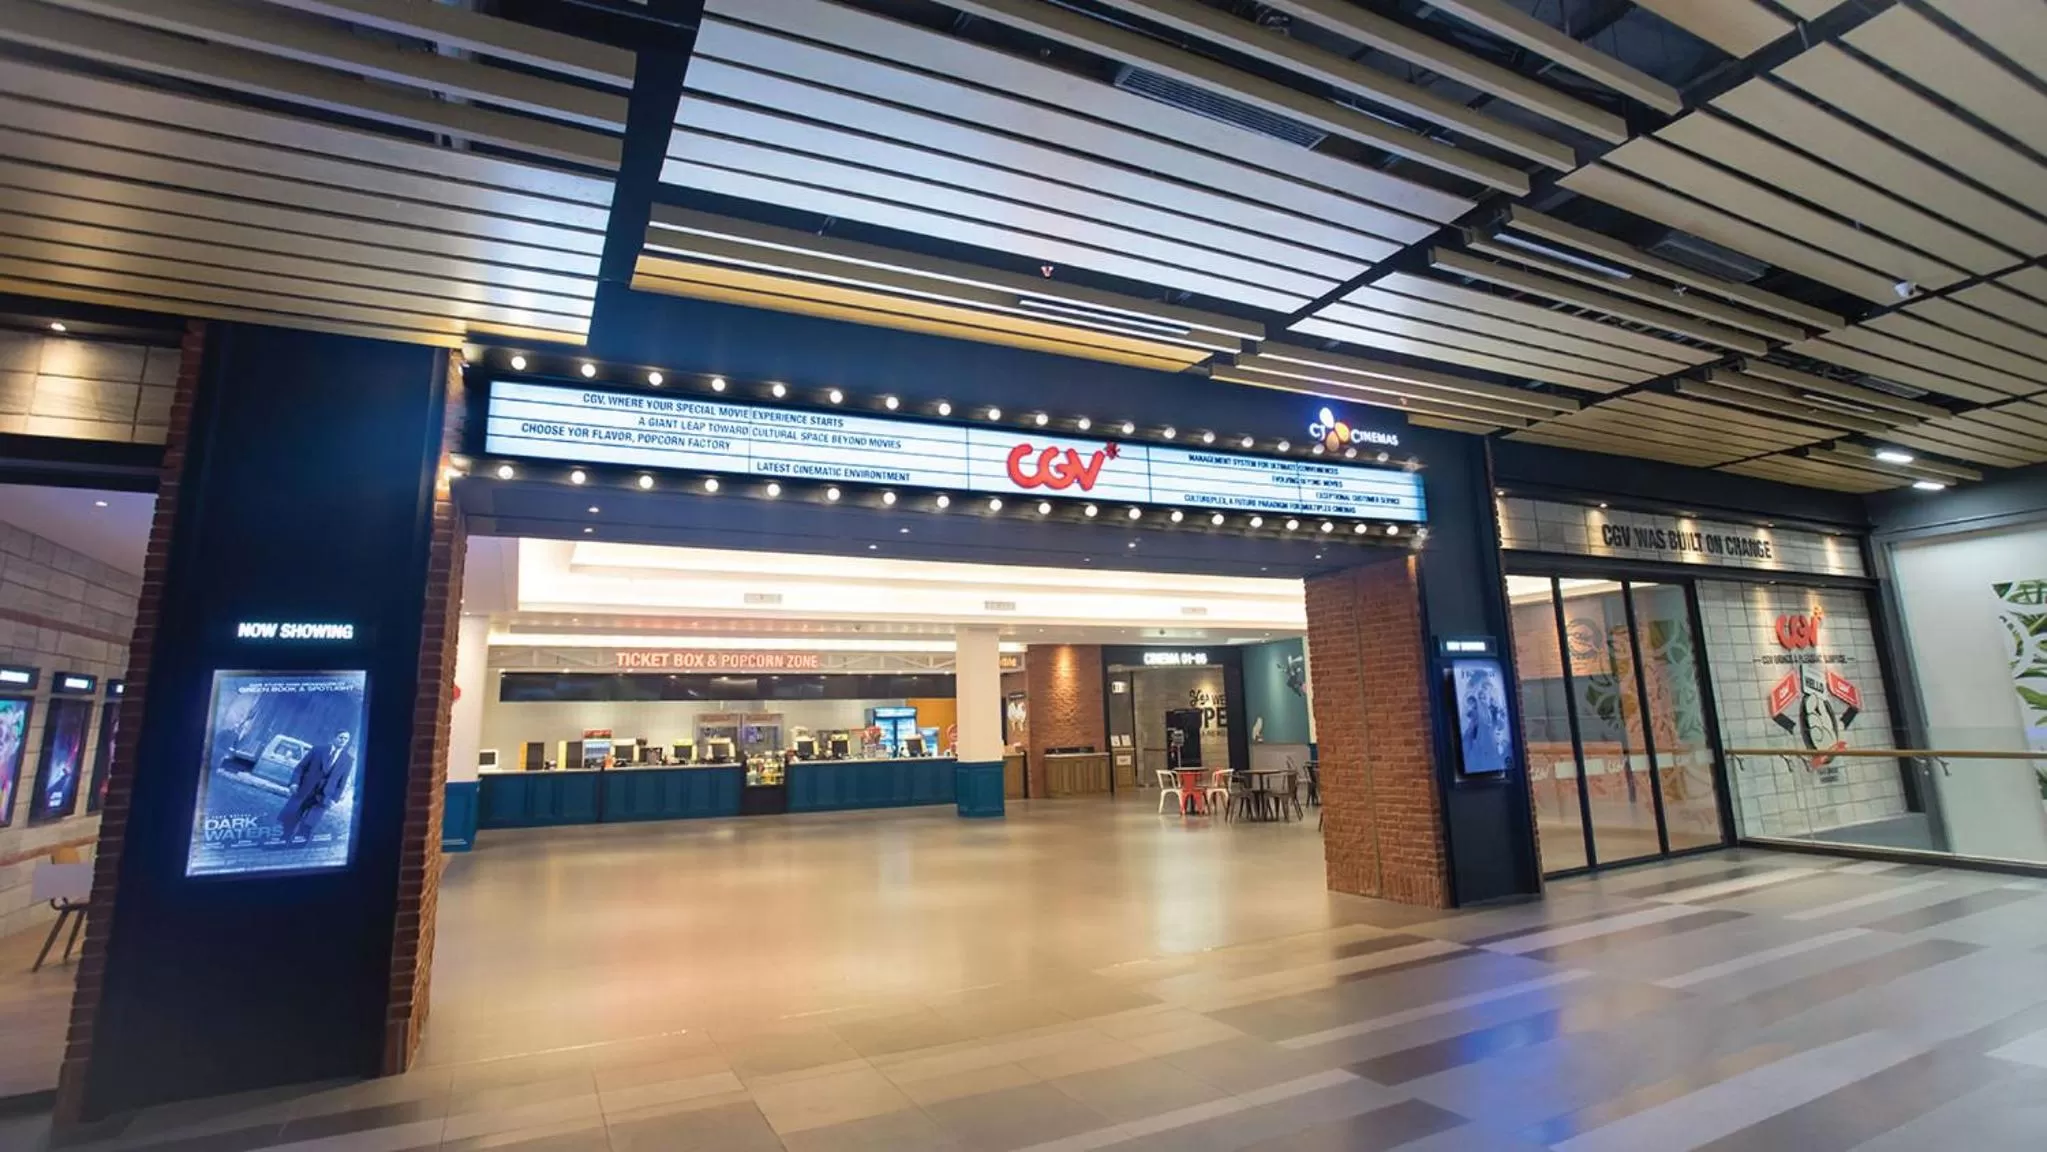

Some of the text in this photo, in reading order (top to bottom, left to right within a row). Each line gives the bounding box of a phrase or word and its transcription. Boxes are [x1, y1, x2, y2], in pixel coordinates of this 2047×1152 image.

[607, 395, 644, 409] WHERE
[646, 399, 674, 411] YOUR
[676, 402, 716, 416] SPECIAL
[719, 406, 749, 419] MOVIE
[752, 410, 807, 425] EXPERIENCE
[810, 415, 845, 428] STARTS
[521, 422, 731, 451] CHOOSE YOR FLAVOR, POPCORN FACTORY
[638, 416, 902, 449] A GIANT LEAP TOWARD CULTURAL SPACE BEYOND MOVIES
[1308, 422, 1399, 447] CJ CINEMAS
[756, 460, 911, 482] LATEST CINEMATIC ENVIRONTMENT
[1006, 443, 1106, 492] CGV
[1601, 523, 1773, 559] CGV WAS BUILT ON CHANGE
[236, 621, 354, 640] NOW SHOWING
[616, 651, 819, 669] TICKET BOX & POPCORN ZONE
[203, 824, 285, 842] WATERS
[204, 815, 259, 832] DARK
